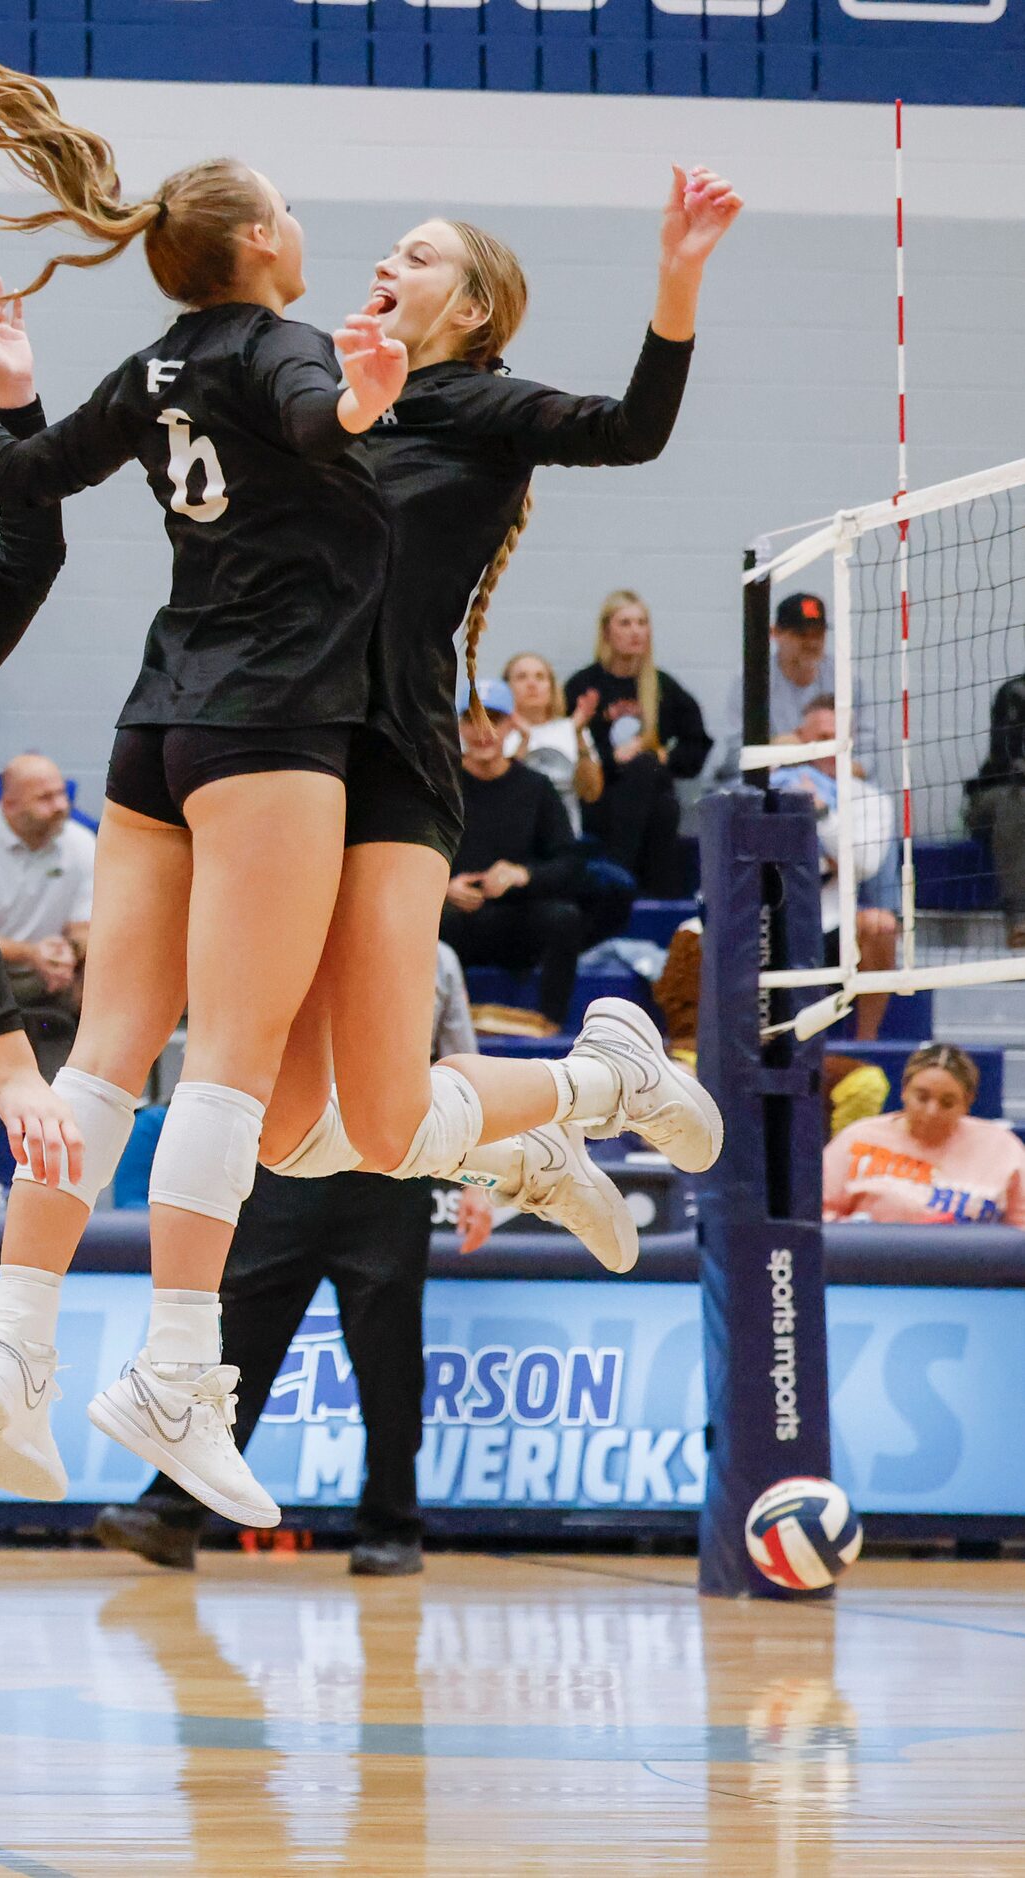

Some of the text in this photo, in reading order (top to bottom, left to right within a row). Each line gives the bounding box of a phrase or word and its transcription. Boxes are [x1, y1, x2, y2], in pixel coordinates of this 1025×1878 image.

[156, 407, 229, 522] 6
[258, 1306, 624, 1427] EMRSON
[766, 1249, 801, 1441] sports imports
[296, 1424, 710, 1504] MVERICKS
